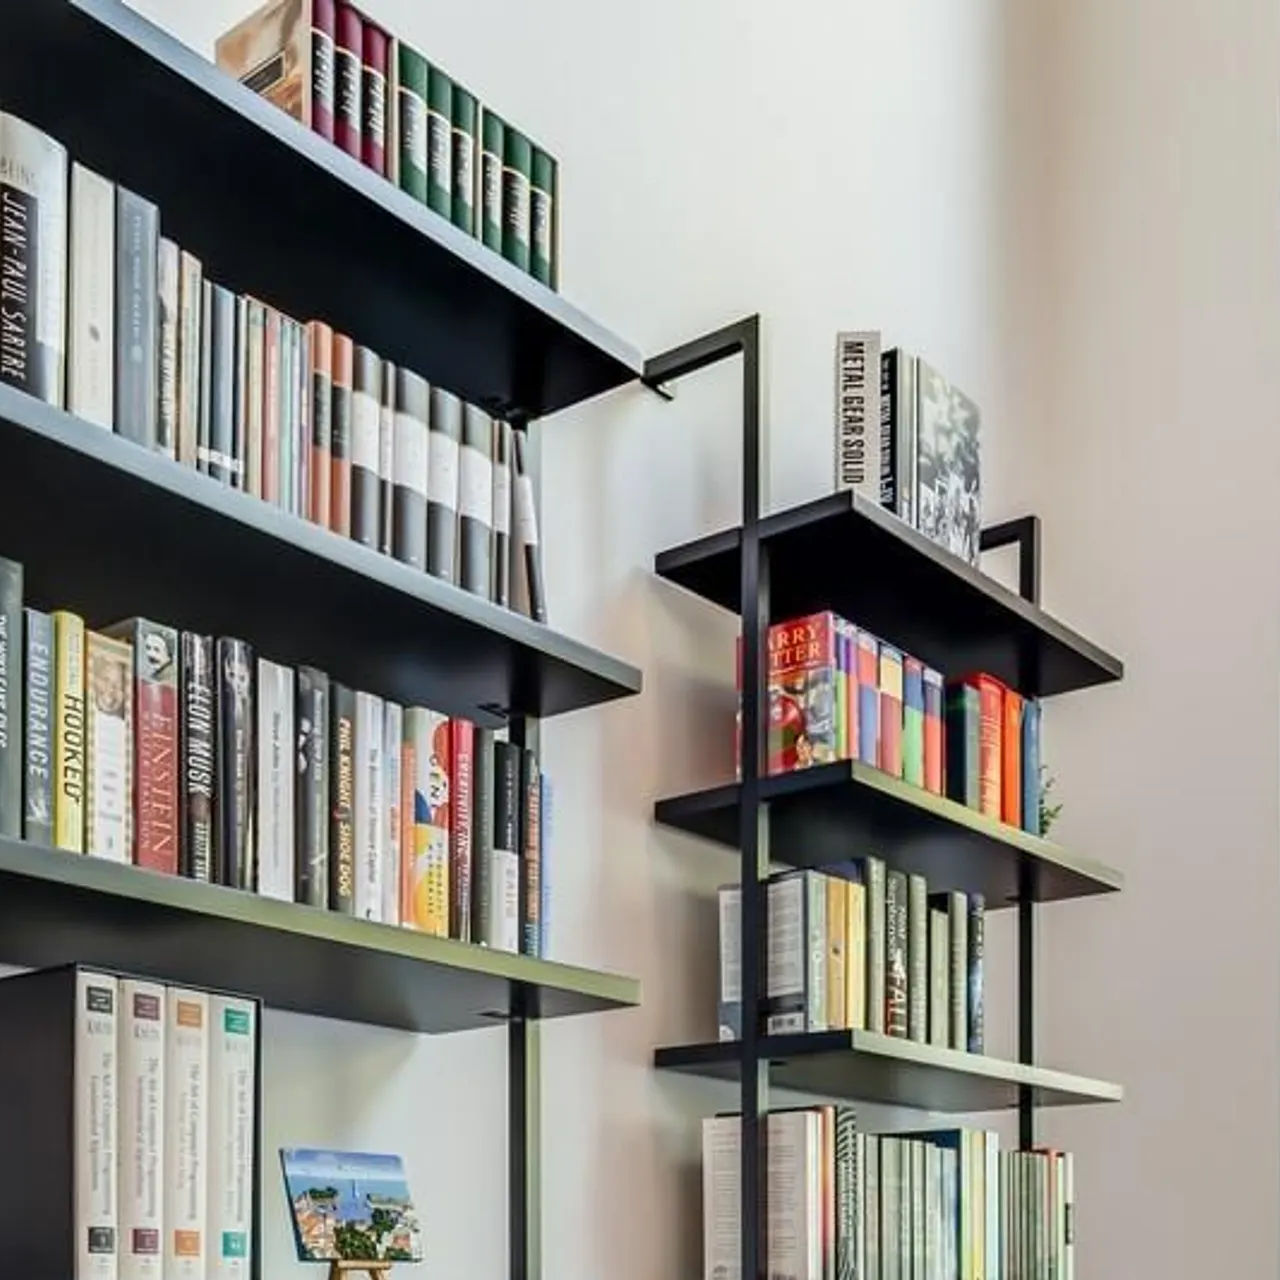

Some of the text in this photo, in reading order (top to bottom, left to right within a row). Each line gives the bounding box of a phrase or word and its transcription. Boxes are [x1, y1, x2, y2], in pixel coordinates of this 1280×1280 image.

[1, 191, 27, 381] JEAN-PAUL SARTRE
[842, 341, 865, 485] METAL GEAR SOLID
[28, 640, 49, 781] ENDURANCE
[63, 693, 84, 805] HOOKED
[188, 683, 212, 800] ELON MUSK
[339, 717, 351, 809] PHIL KNIGHT
[151, 711, 173, 852] EINSTEIN
[339, 821, 351, 898] SHOE DOG
[887, 974, 907, 1037] FALL
